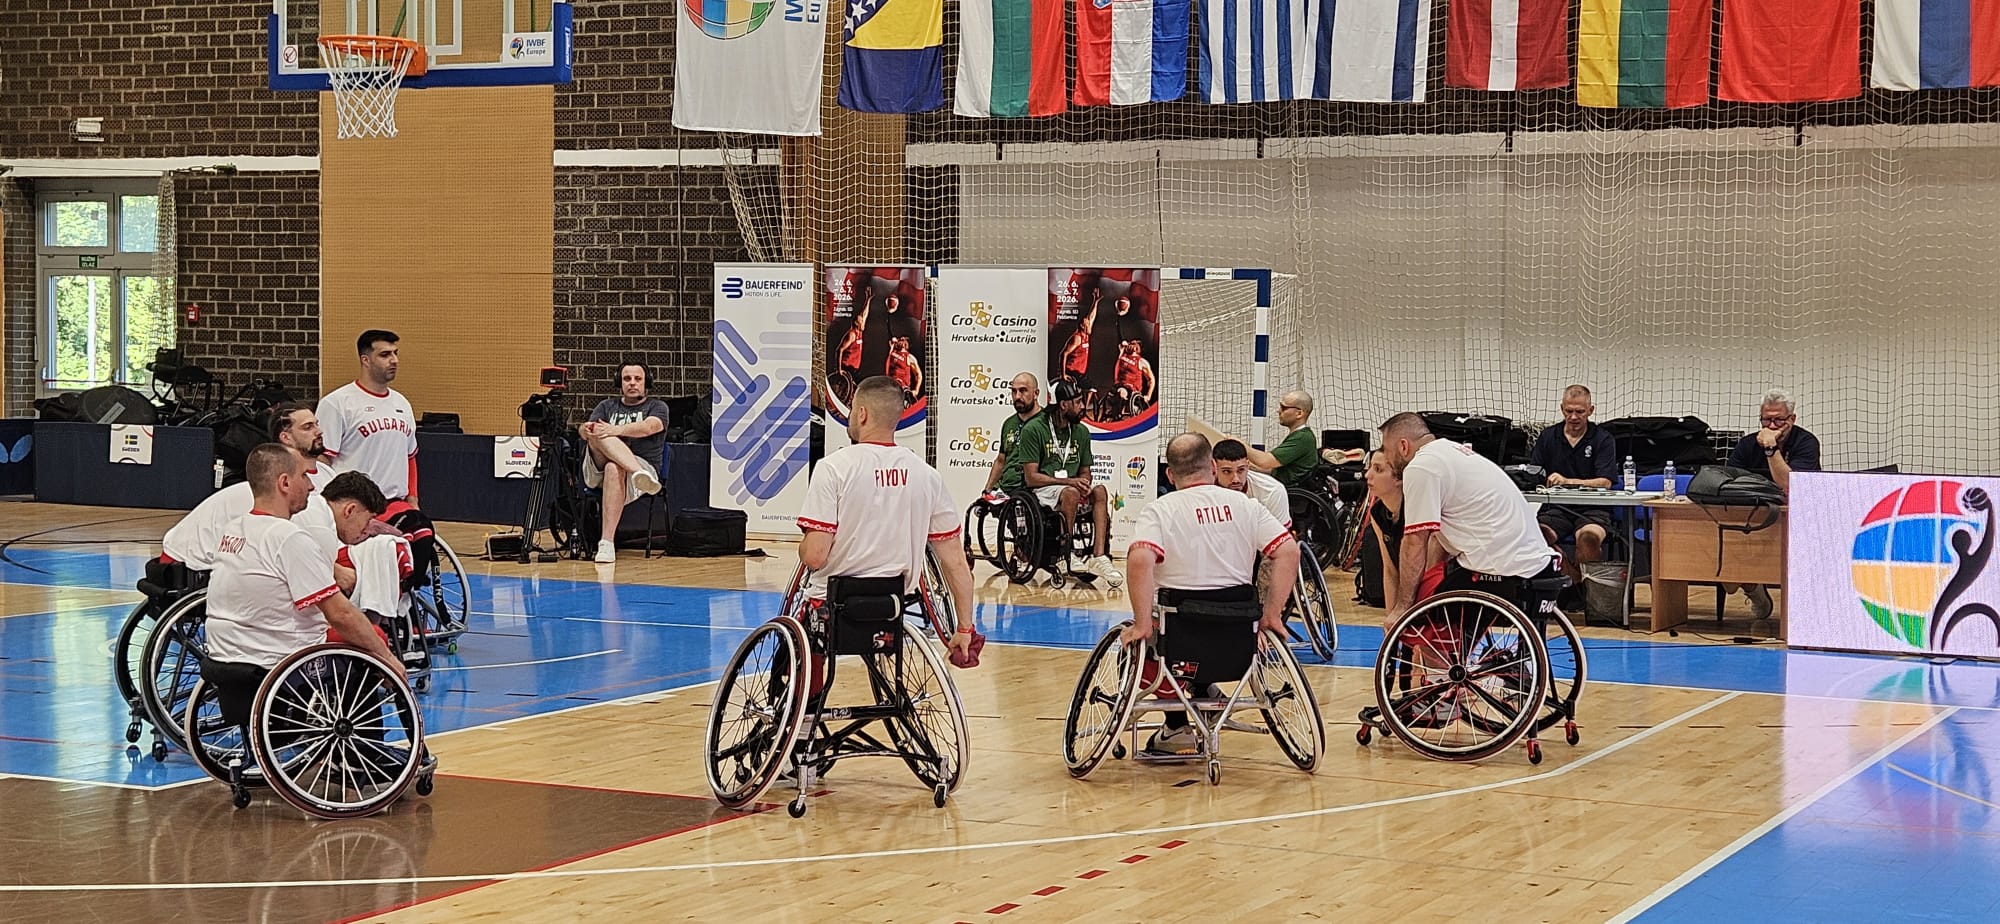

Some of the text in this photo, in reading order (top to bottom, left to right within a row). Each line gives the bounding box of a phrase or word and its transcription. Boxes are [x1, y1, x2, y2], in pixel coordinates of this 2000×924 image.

[526, 39, 546, 47] IWBF
[1056, 295, 1079, 303] 2026.
[951, 314, 1037, 326] Cro Casino
[951, 333, 1037, 344] Hrvatska Lutrija
[950, 377, 1014, 389] Cro Cas
[950, 396, 994, 405] Hrvatska
[949, 440, 971, 451] Cro
[949, 458, 993, 468] Hrvatska
[875, 469, 908, 488] FIYOV
[1195, 505, 1233, 524] ATILA
[434, 565, 443, 604] EXTRA
